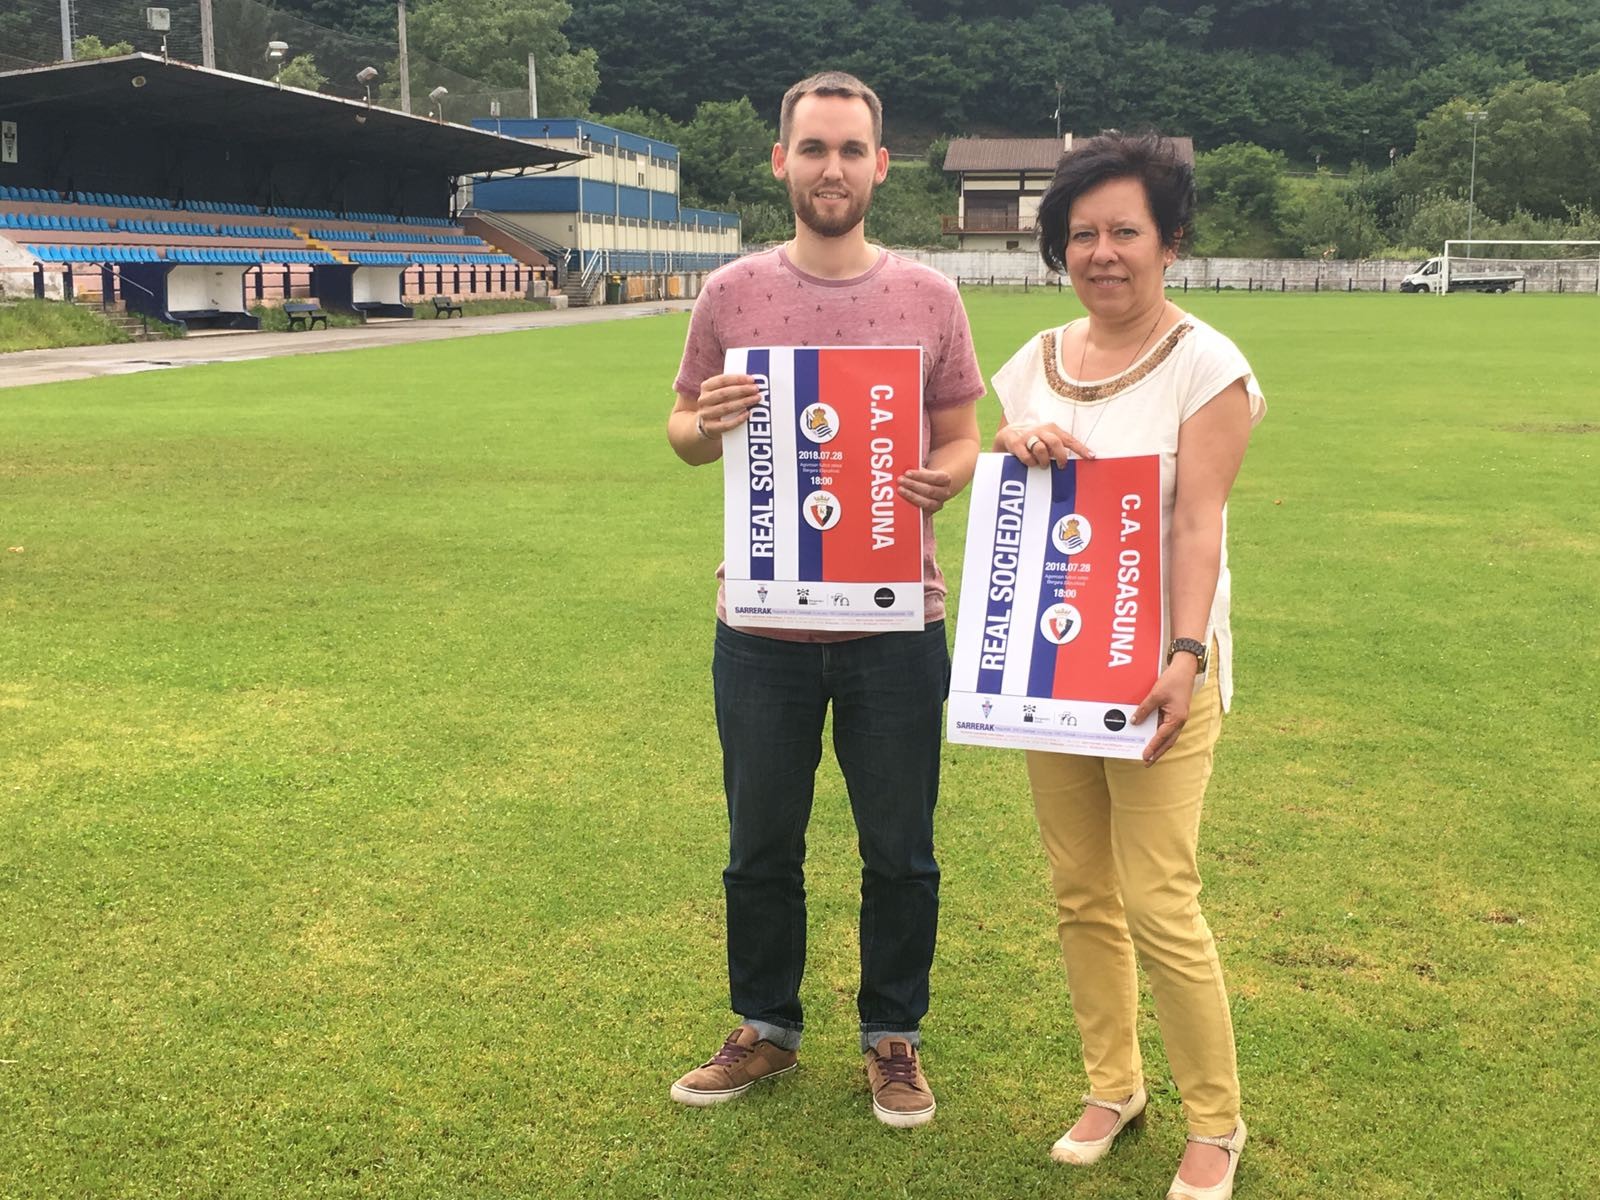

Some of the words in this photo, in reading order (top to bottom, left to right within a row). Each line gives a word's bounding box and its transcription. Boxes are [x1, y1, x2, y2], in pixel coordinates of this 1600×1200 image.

[870, 384, 894, 431] C.A.
[798, 450, 843, 461] 2018.07.28
[810, 476, 833, 485] 18:00
[870, 437, 895, 551] OSASUNA
[751, 497, 775, 558] REAL
[990, 479, 1026, 603] SOCIEDAD
[1119, 494, 1142, 542] C.A.
[1044, 561, 1091, 573] 2018.07.28
[735, 606, 772, 615] SARRERAK
[1053, 588, 1077, 599] 18:00
[1107, 549, 1141, 668] OSASUNA
[981, 607, 1012, 671] REAL
[956, 720, 995, 732] SARRERAK
